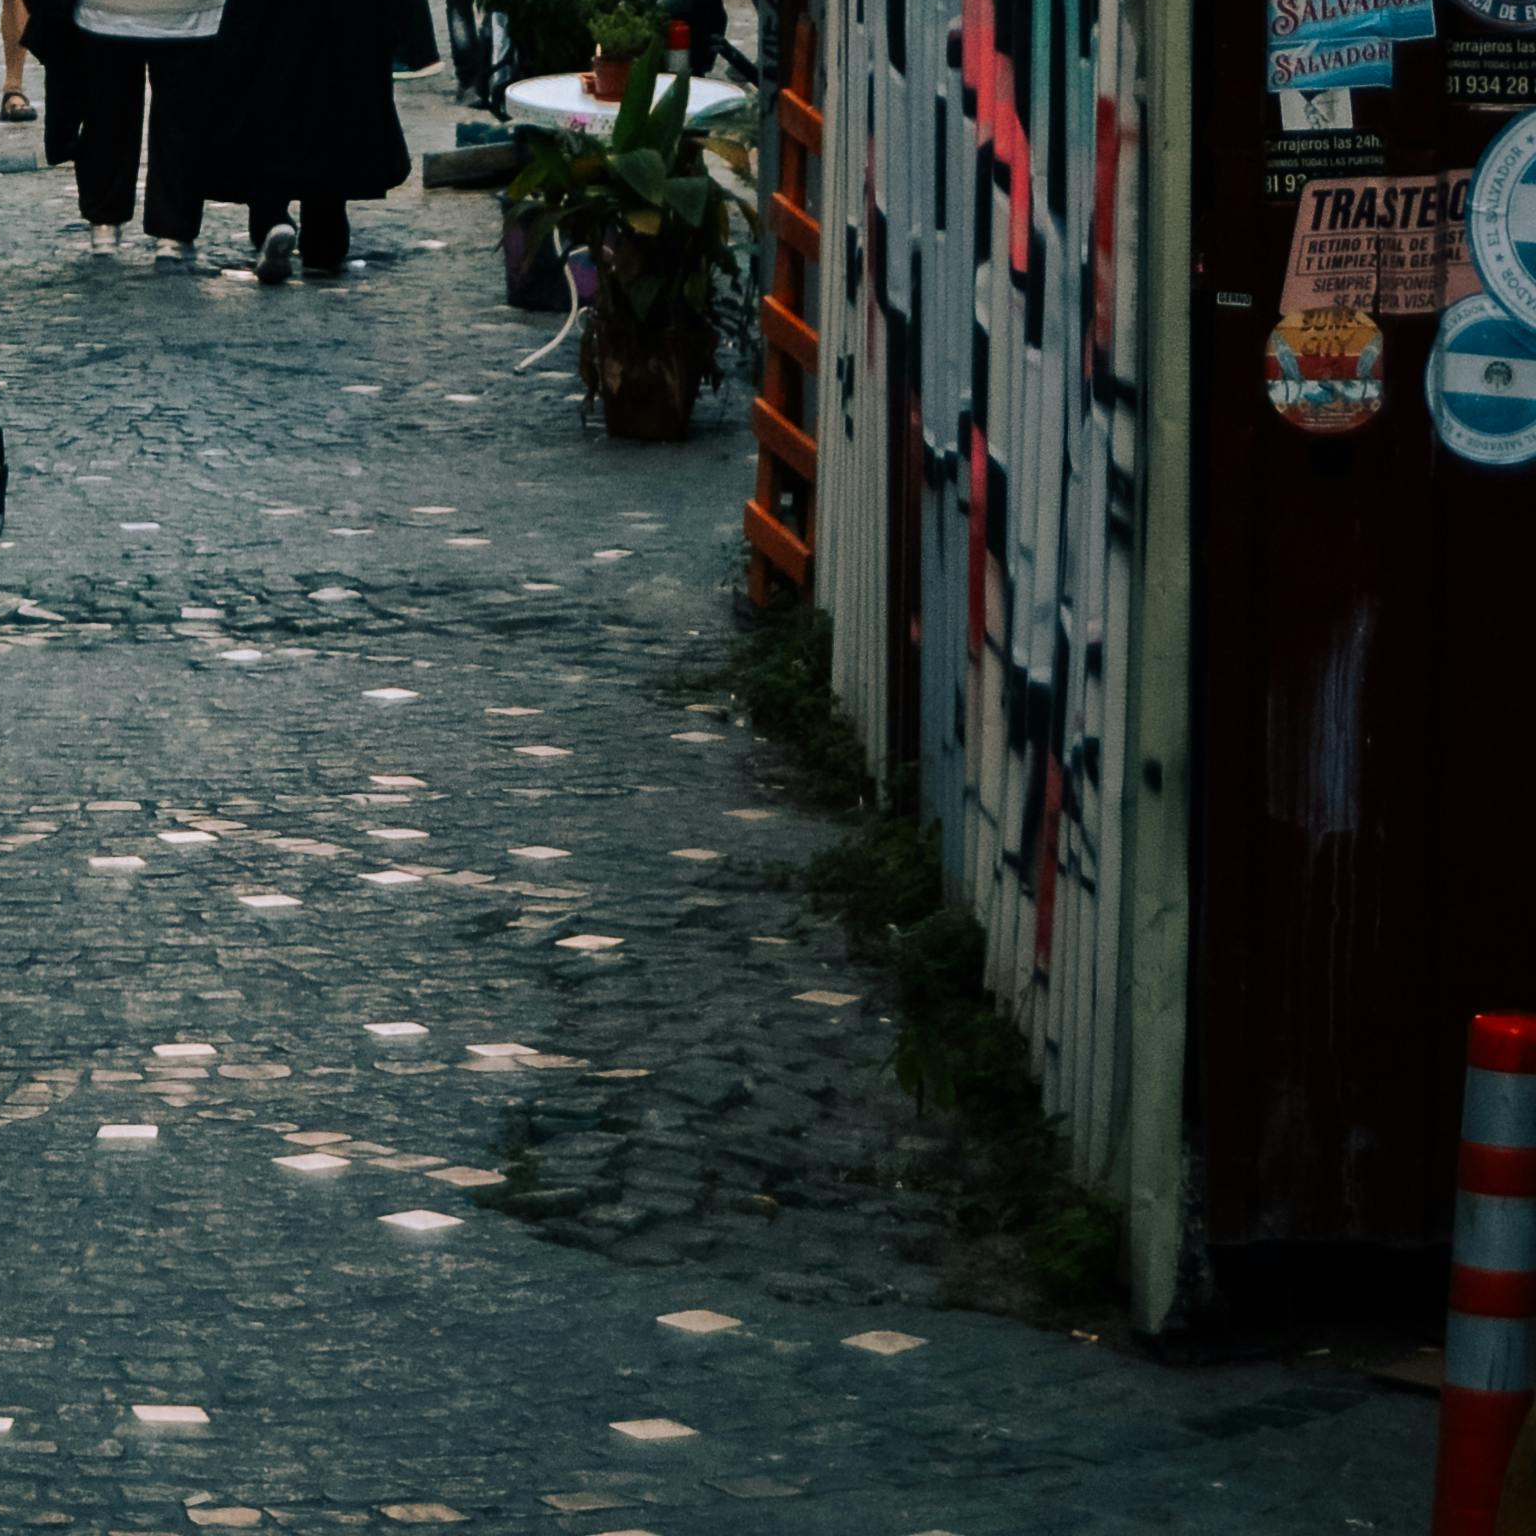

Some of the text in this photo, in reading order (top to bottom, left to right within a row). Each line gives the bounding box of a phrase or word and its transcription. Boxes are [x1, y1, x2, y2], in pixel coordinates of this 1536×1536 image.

[1499, 3, 1517, 20] DE
[1272, 42, 1390, 85] SALVADOR
[1466, 75, 1500, 95] 934
[1506, 75, 1529, 95] 28
[1333, 135, 1353, 149] las
[1484, 145, 1524, 247] EL SALVADOR
[1308, 237, 1361, 254] RETIRO
[1409, 236, 1428, 252] DE
[1312, 274, 1374, 293] SIEMPRE
[1404, 291, 1436, 308] VISA
